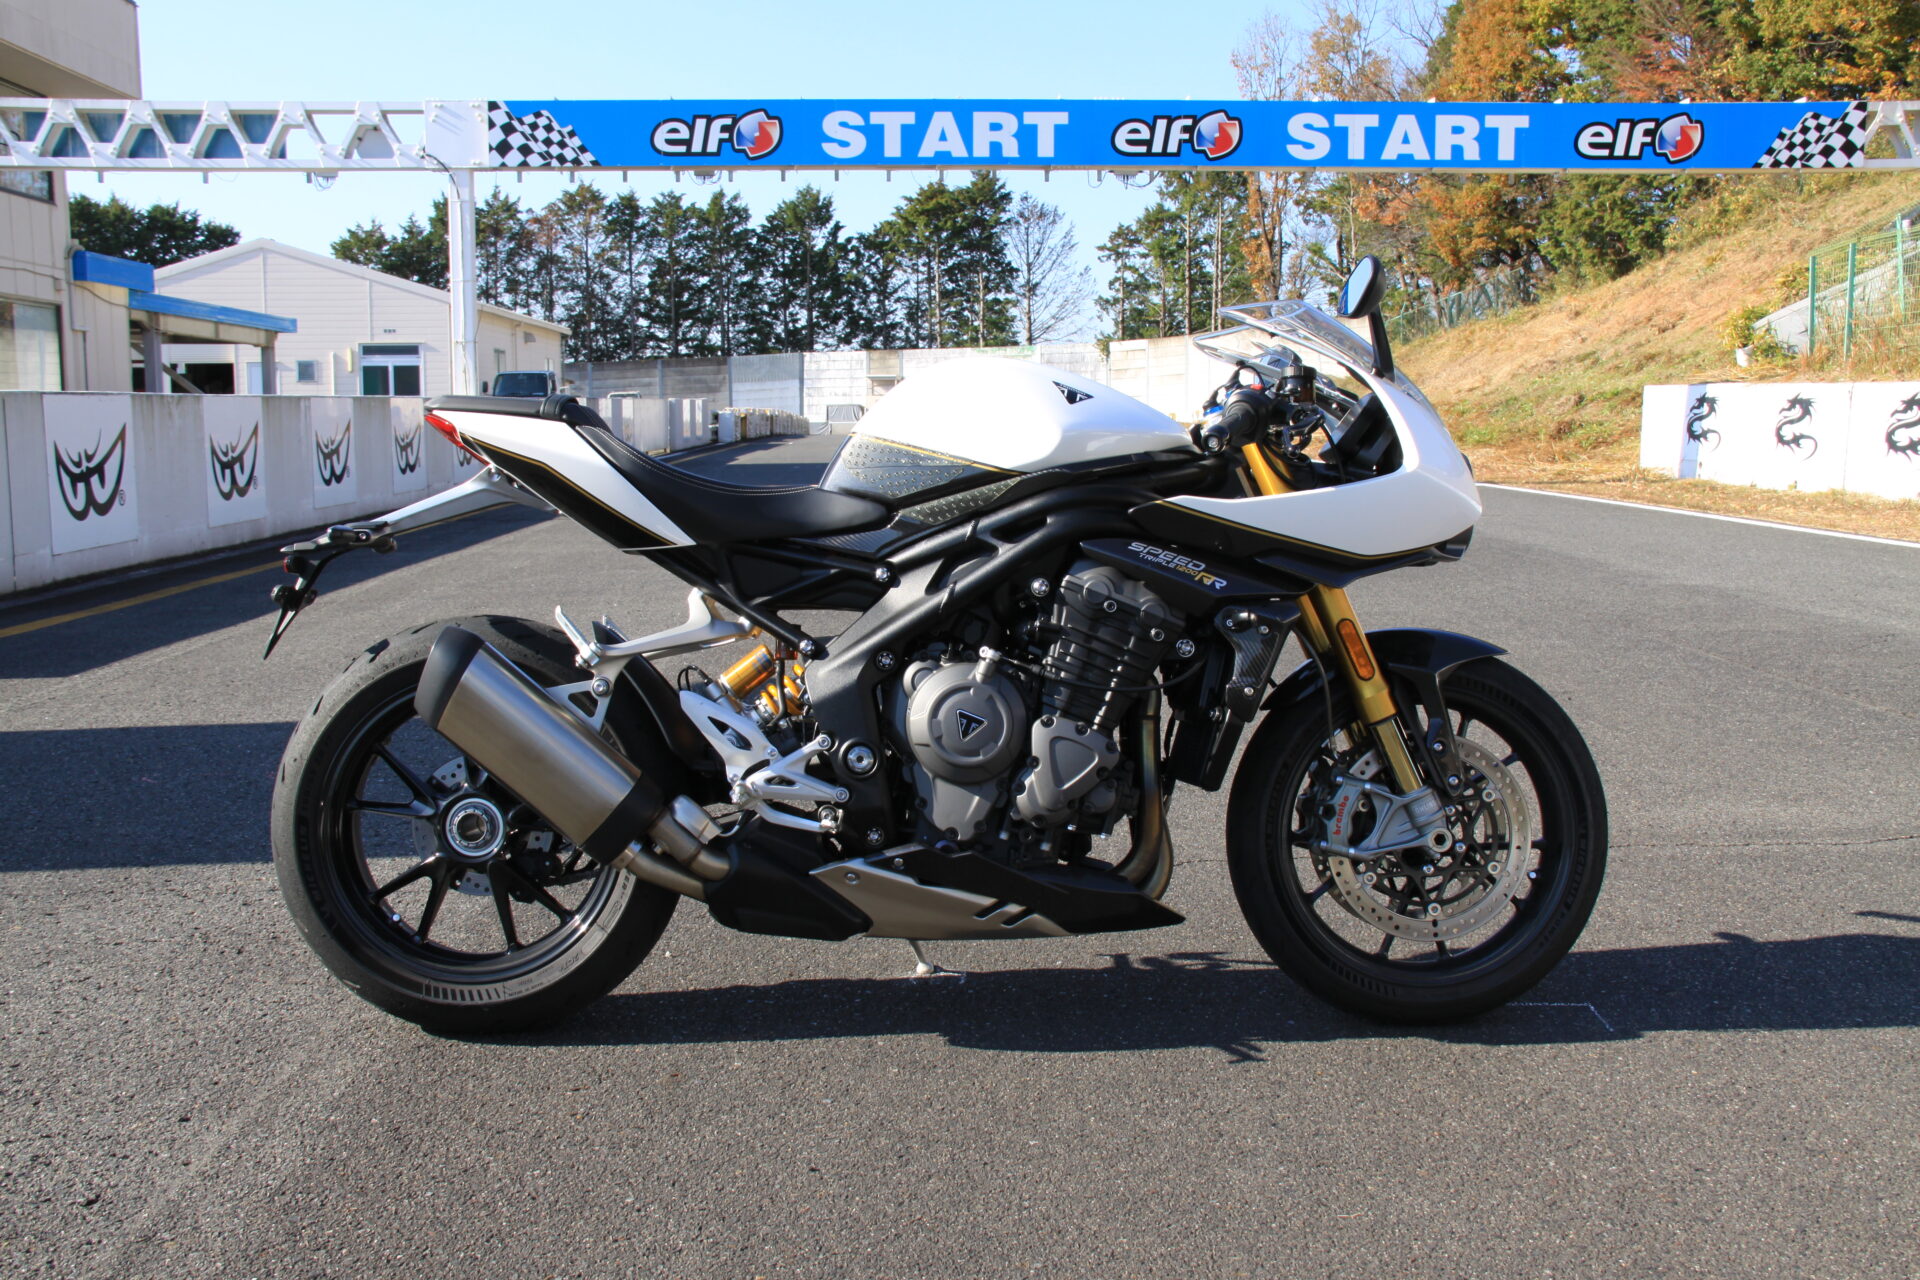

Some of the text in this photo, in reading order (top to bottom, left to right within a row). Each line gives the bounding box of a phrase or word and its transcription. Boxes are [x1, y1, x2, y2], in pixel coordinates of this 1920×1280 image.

[652, 110, 1658, 161] elf START elf START elf
[1128, 541, 1206, 571] SPEED
[1139, 552, 1227, 590] TRIPLE 1200 RR
[1333, 795, 1349, 836] brembo
